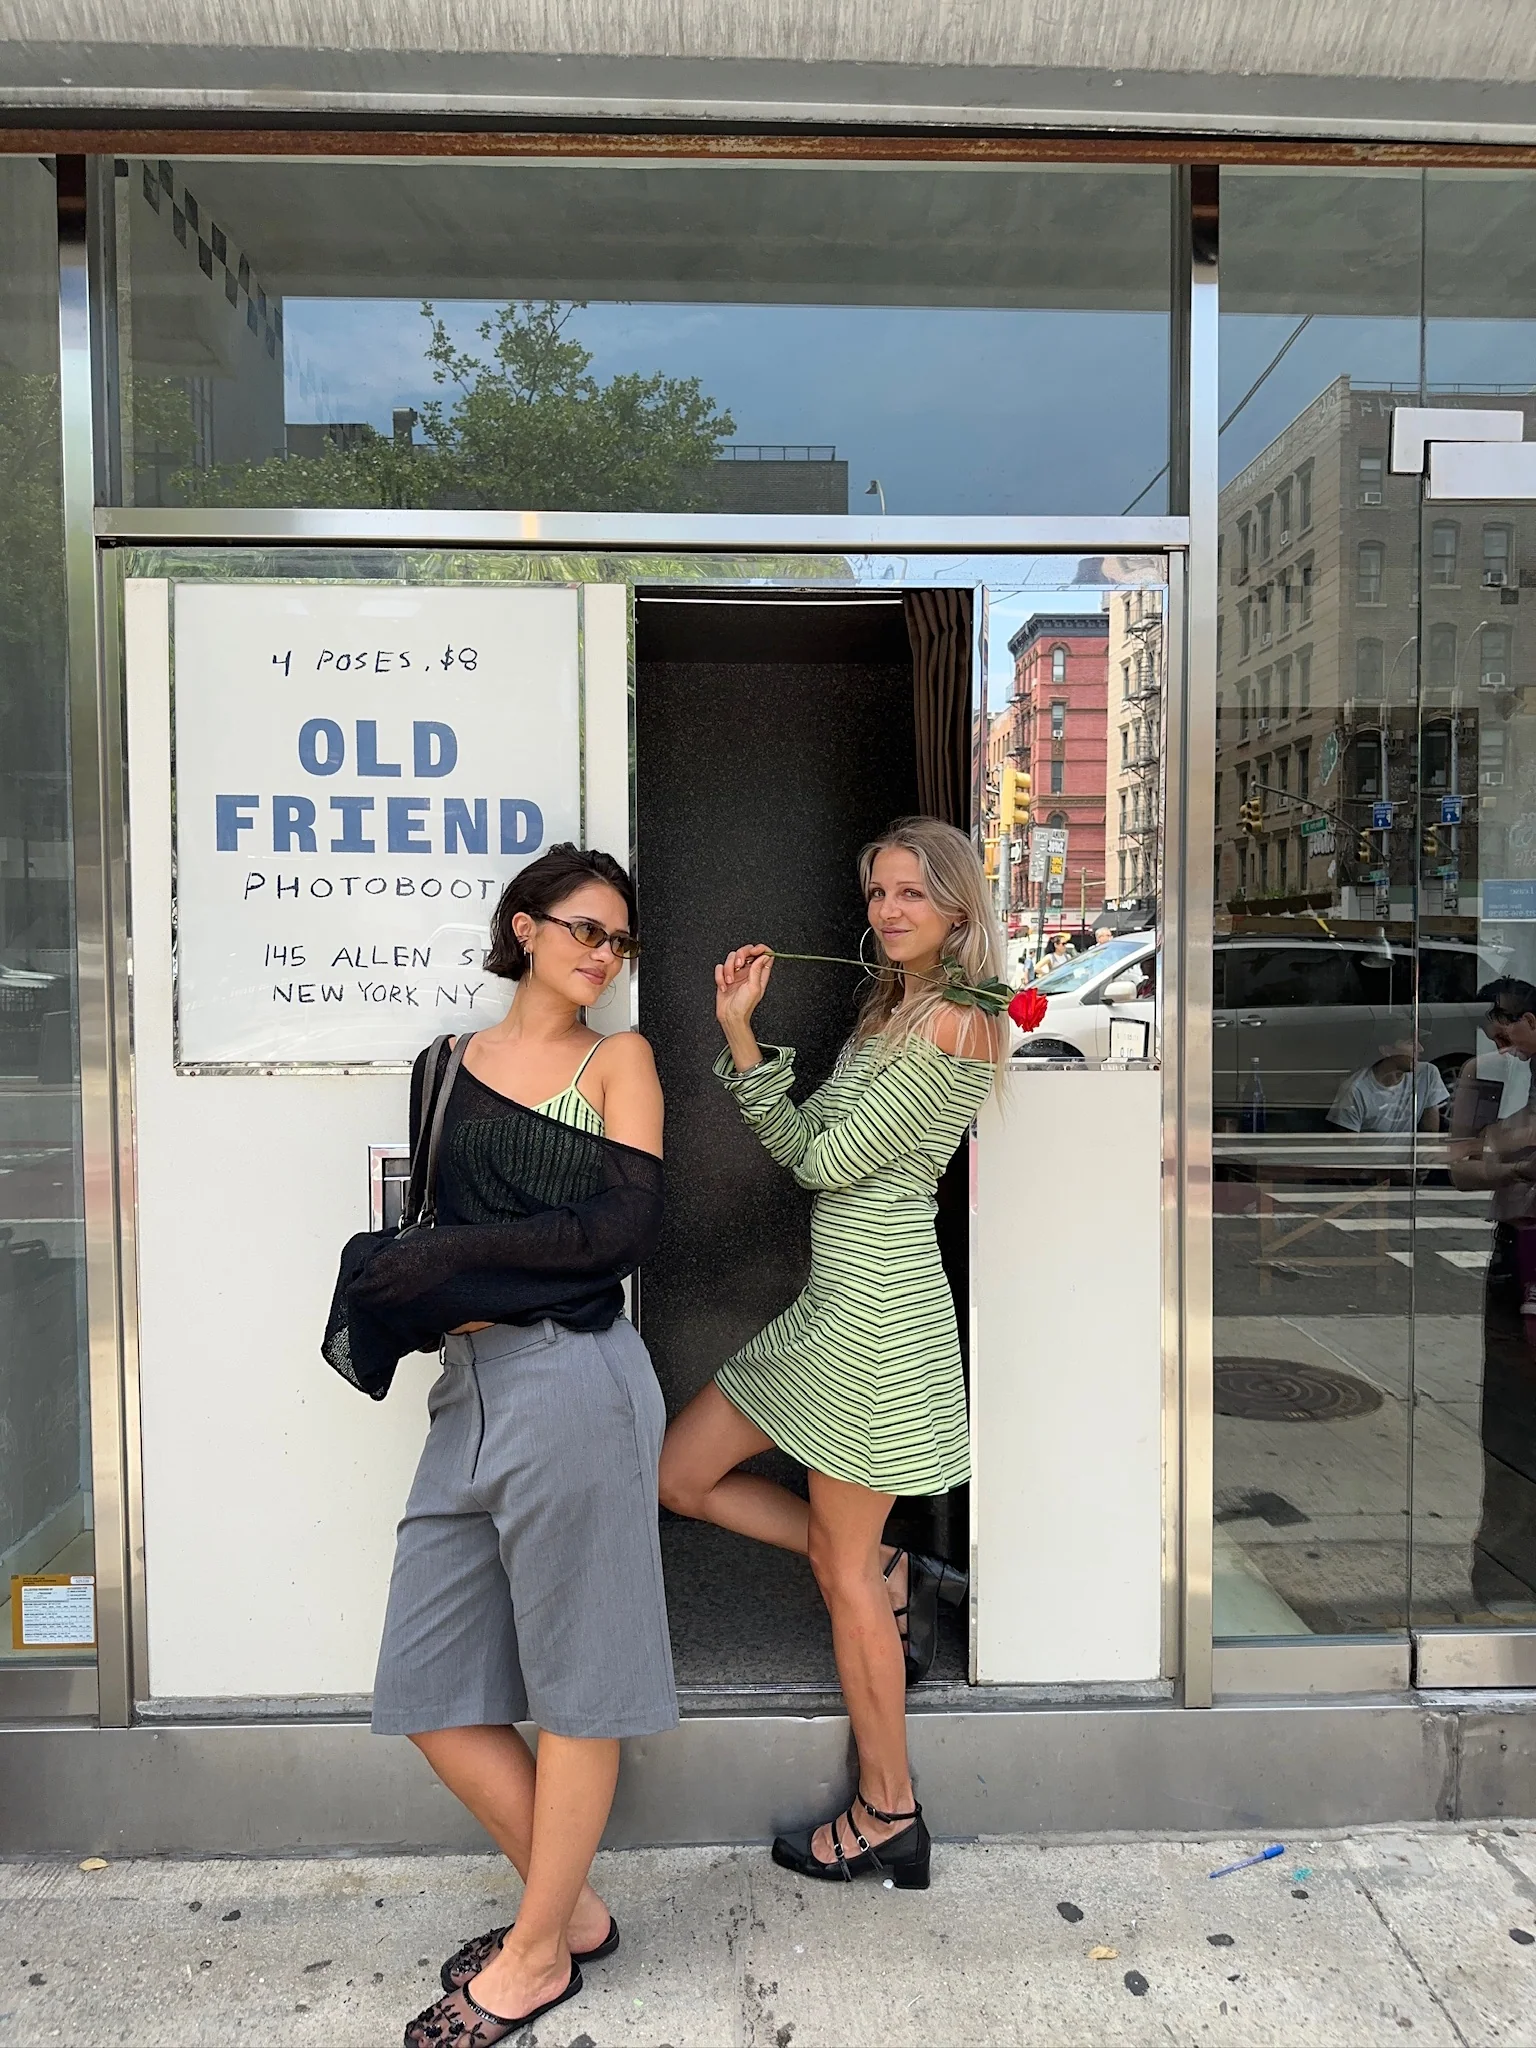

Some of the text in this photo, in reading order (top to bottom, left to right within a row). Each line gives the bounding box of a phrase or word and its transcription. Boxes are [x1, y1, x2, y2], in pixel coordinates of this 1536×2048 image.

[272, 650, 292, 677] 4
[440, 643, 478, 671] $8
[298, 718, 458, 778] OLD
[215, 794, 544, 855] FRIEND
[244, 872, 505, 900] PHOTOBOOT
[265, 943, 306, 967] 145
[330, 945, 431, 968] ALLEN
[273, 981, 484, 1009] NEW YORK NY
